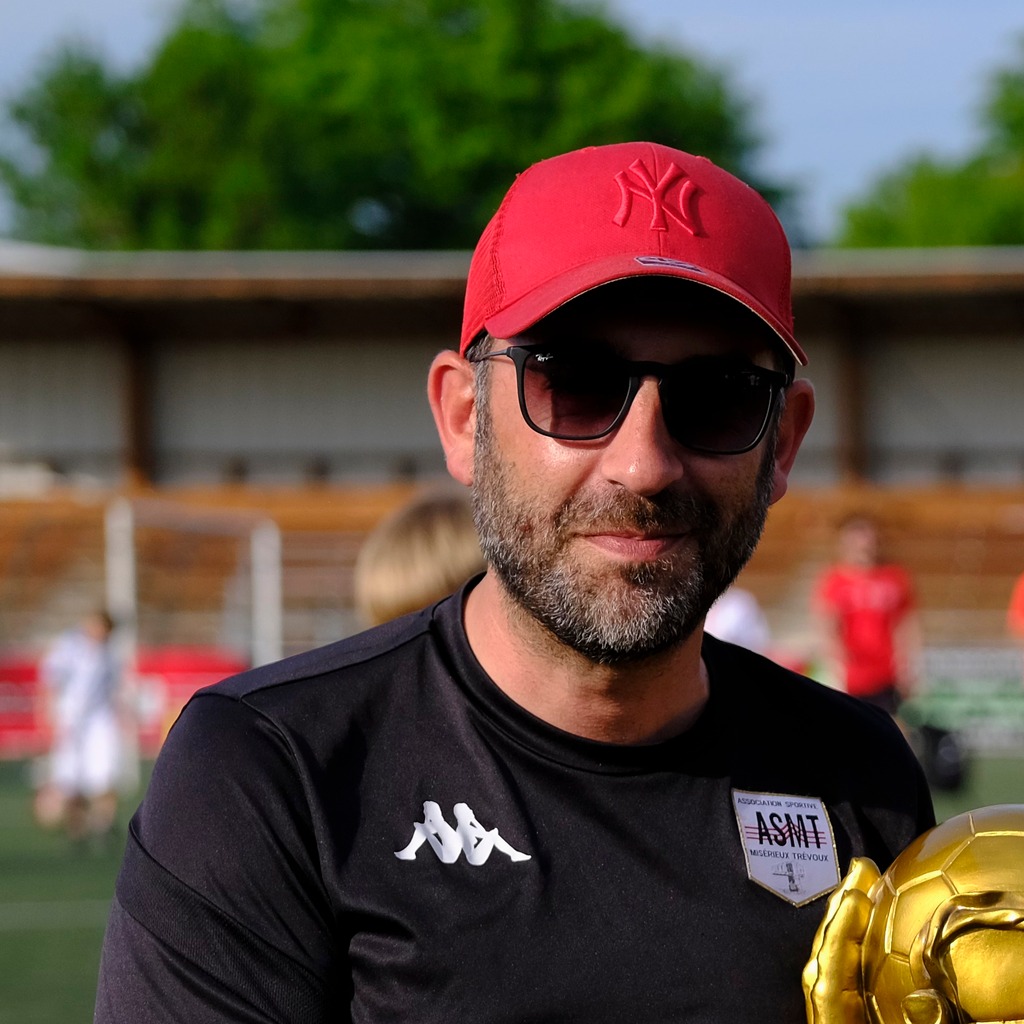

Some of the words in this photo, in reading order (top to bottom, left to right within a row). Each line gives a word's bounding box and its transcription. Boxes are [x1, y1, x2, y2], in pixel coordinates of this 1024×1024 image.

[612, 158, 704, 237] NY
[737, 797, 782, 807] ASSOCIATION
[785, 801, 818, 810] SPORTIVE
[756, 811, 821, 849] ASMT
